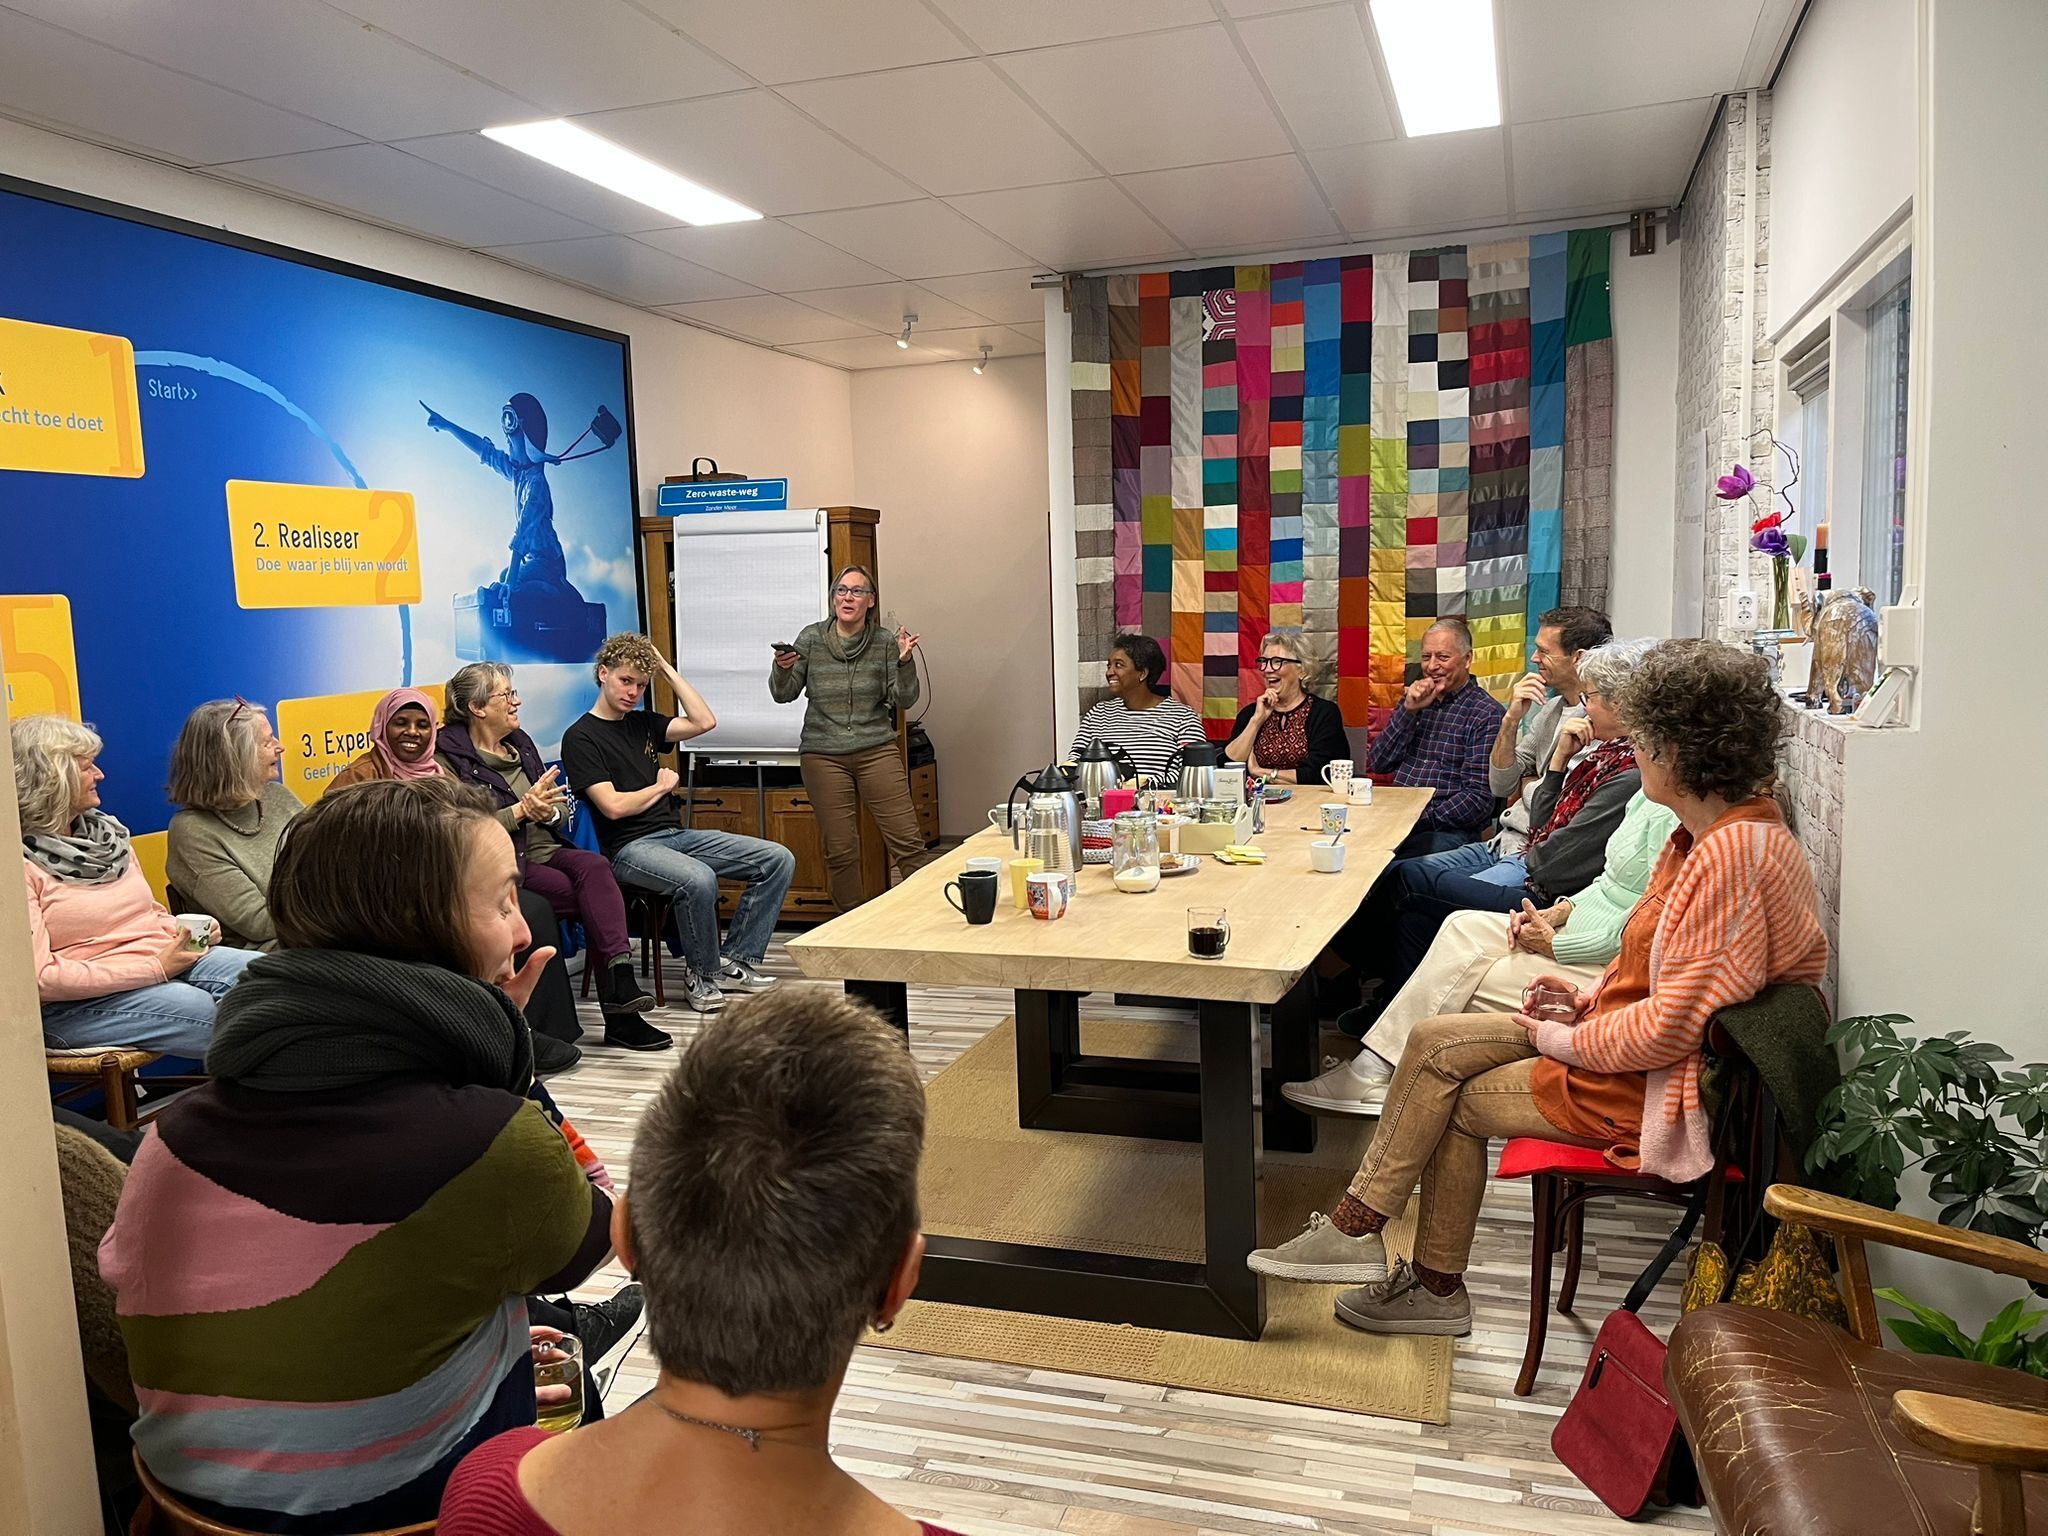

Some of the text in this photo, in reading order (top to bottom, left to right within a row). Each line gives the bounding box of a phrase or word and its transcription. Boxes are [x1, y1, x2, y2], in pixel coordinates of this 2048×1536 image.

[0, 405, 104, 432] cht toe doet
[685, 487, 758, 499] Zero-waste-weg
[253, 522, 359, 550] 2. Realiseer
[368, 490, 422, 606] 2
[256, 557, 408, 575] Doe waar je blij van wordt
[301, 733, 316, 757] 3.
[303, 762, 330, 780] Geef
